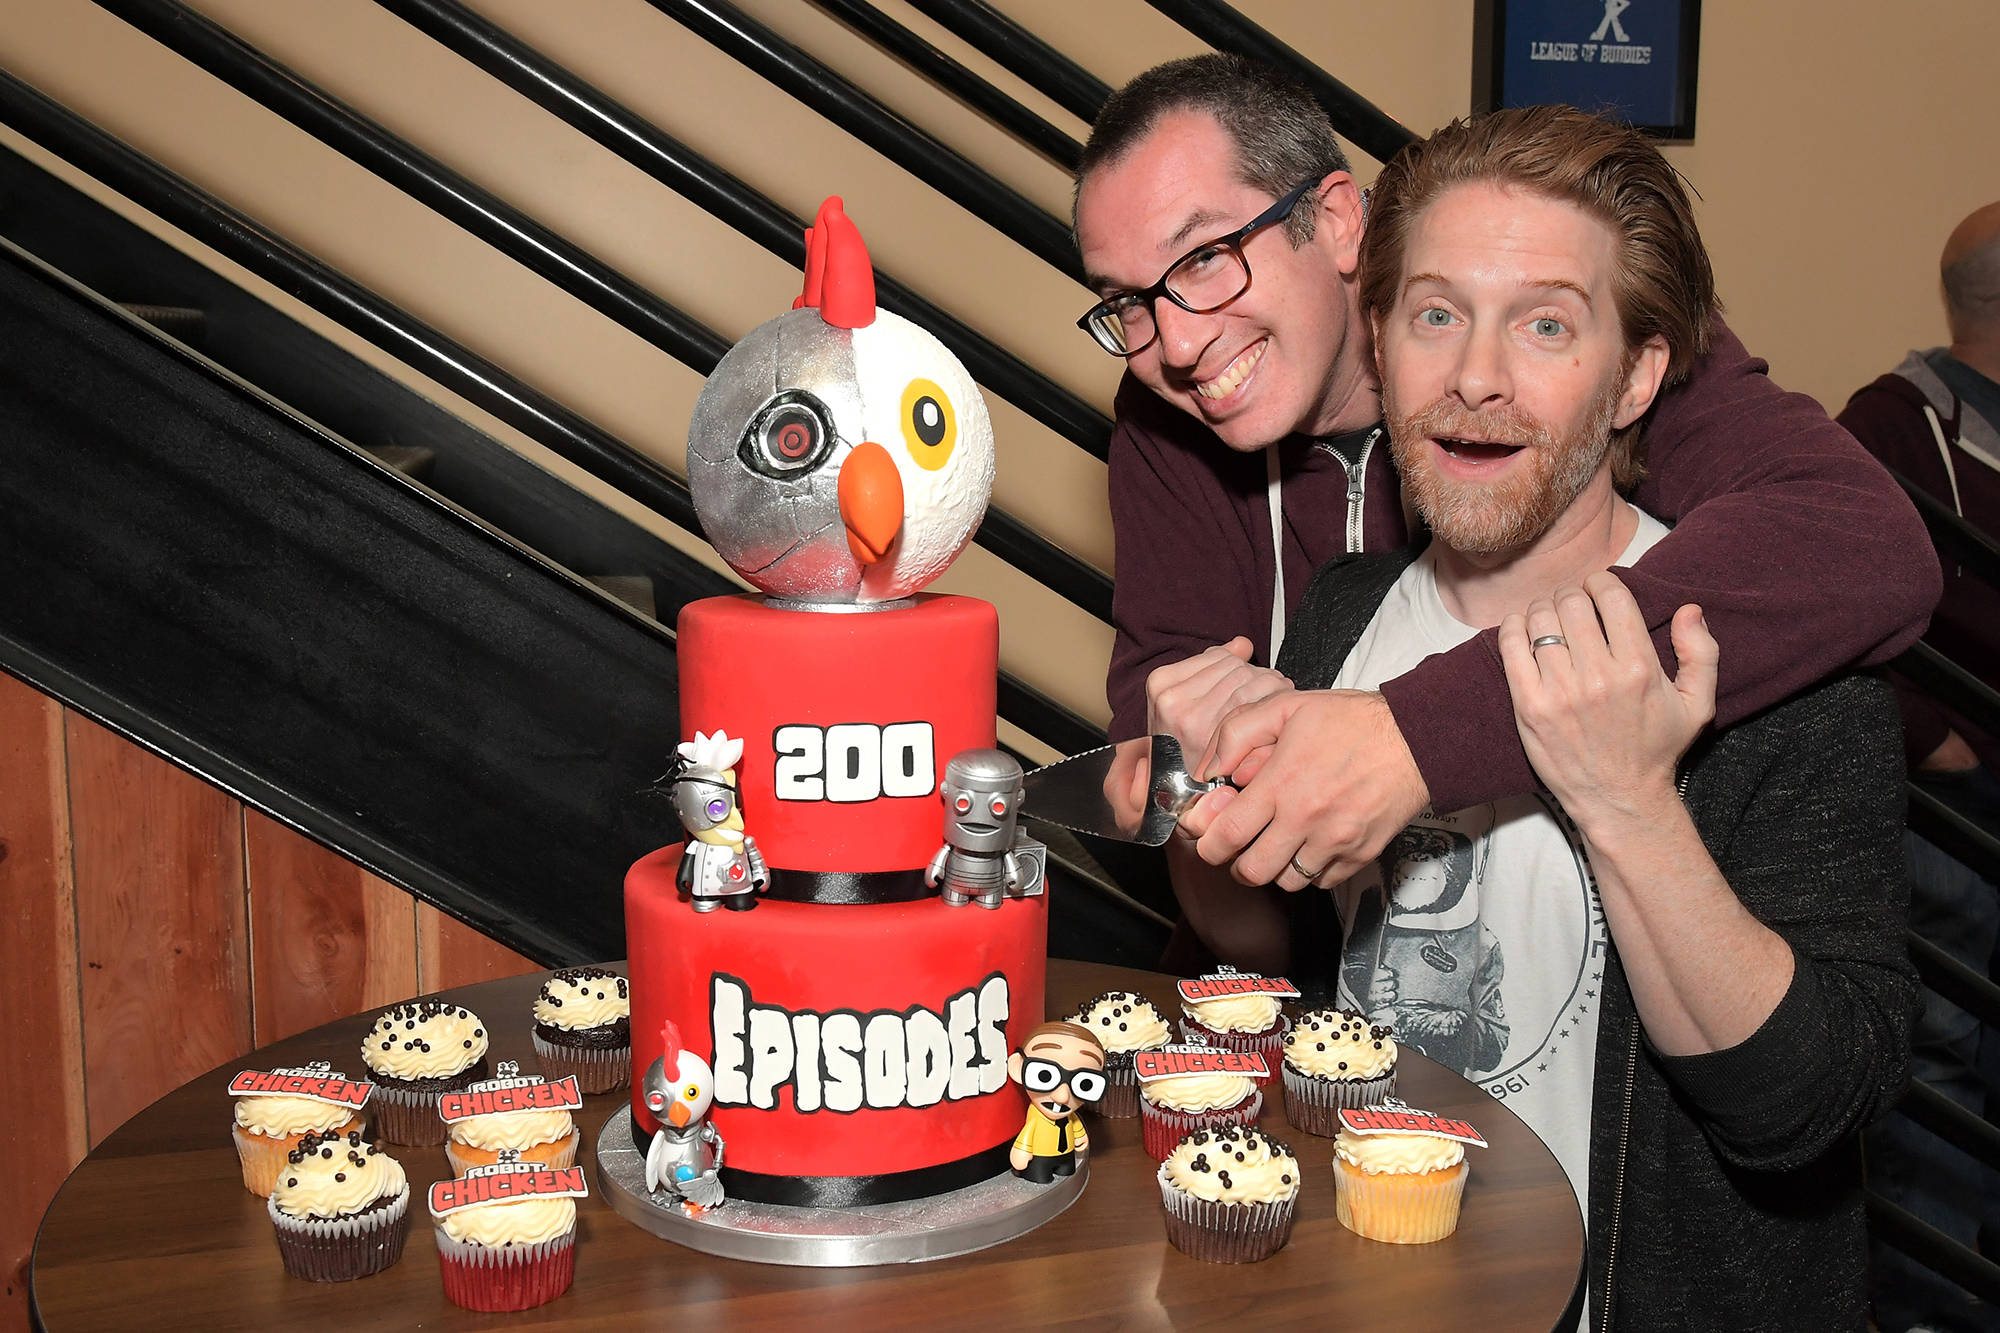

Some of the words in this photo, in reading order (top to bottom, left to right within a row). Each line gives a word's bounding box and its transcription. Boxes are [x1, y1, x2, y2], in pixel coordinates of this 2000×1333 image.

[1530, 42, 1578, 62] LEAGUE
[1581, 44, 1598, 63] OF
[1600, 45, 1652, 65] BUDDIES
[773, 721, 936, 802] 200
[1180, 977, 1297, 999] CHICKEN
[711, 971, 1011, 1113] EPISODES
[1165, 1045, 1229, 1054] ROBOT
[273, 1068, 341, 1080] ROBOT
[1136, 1052, 1267, 1077] CHICKEN
[231, 1071, 371, 1105] CHICKEN
[441, 1077, 580, 1120] CHICKEN
[472, 1077, 540, 1094] ROBOT
[1485, 1073, 1530, 1100] 961
[1341, 1109, 1482, 1141] CHICKEN
[467, 1163, 545, 1179] ROBOT
[432, 1168, 585, 1212] CHICKEN
